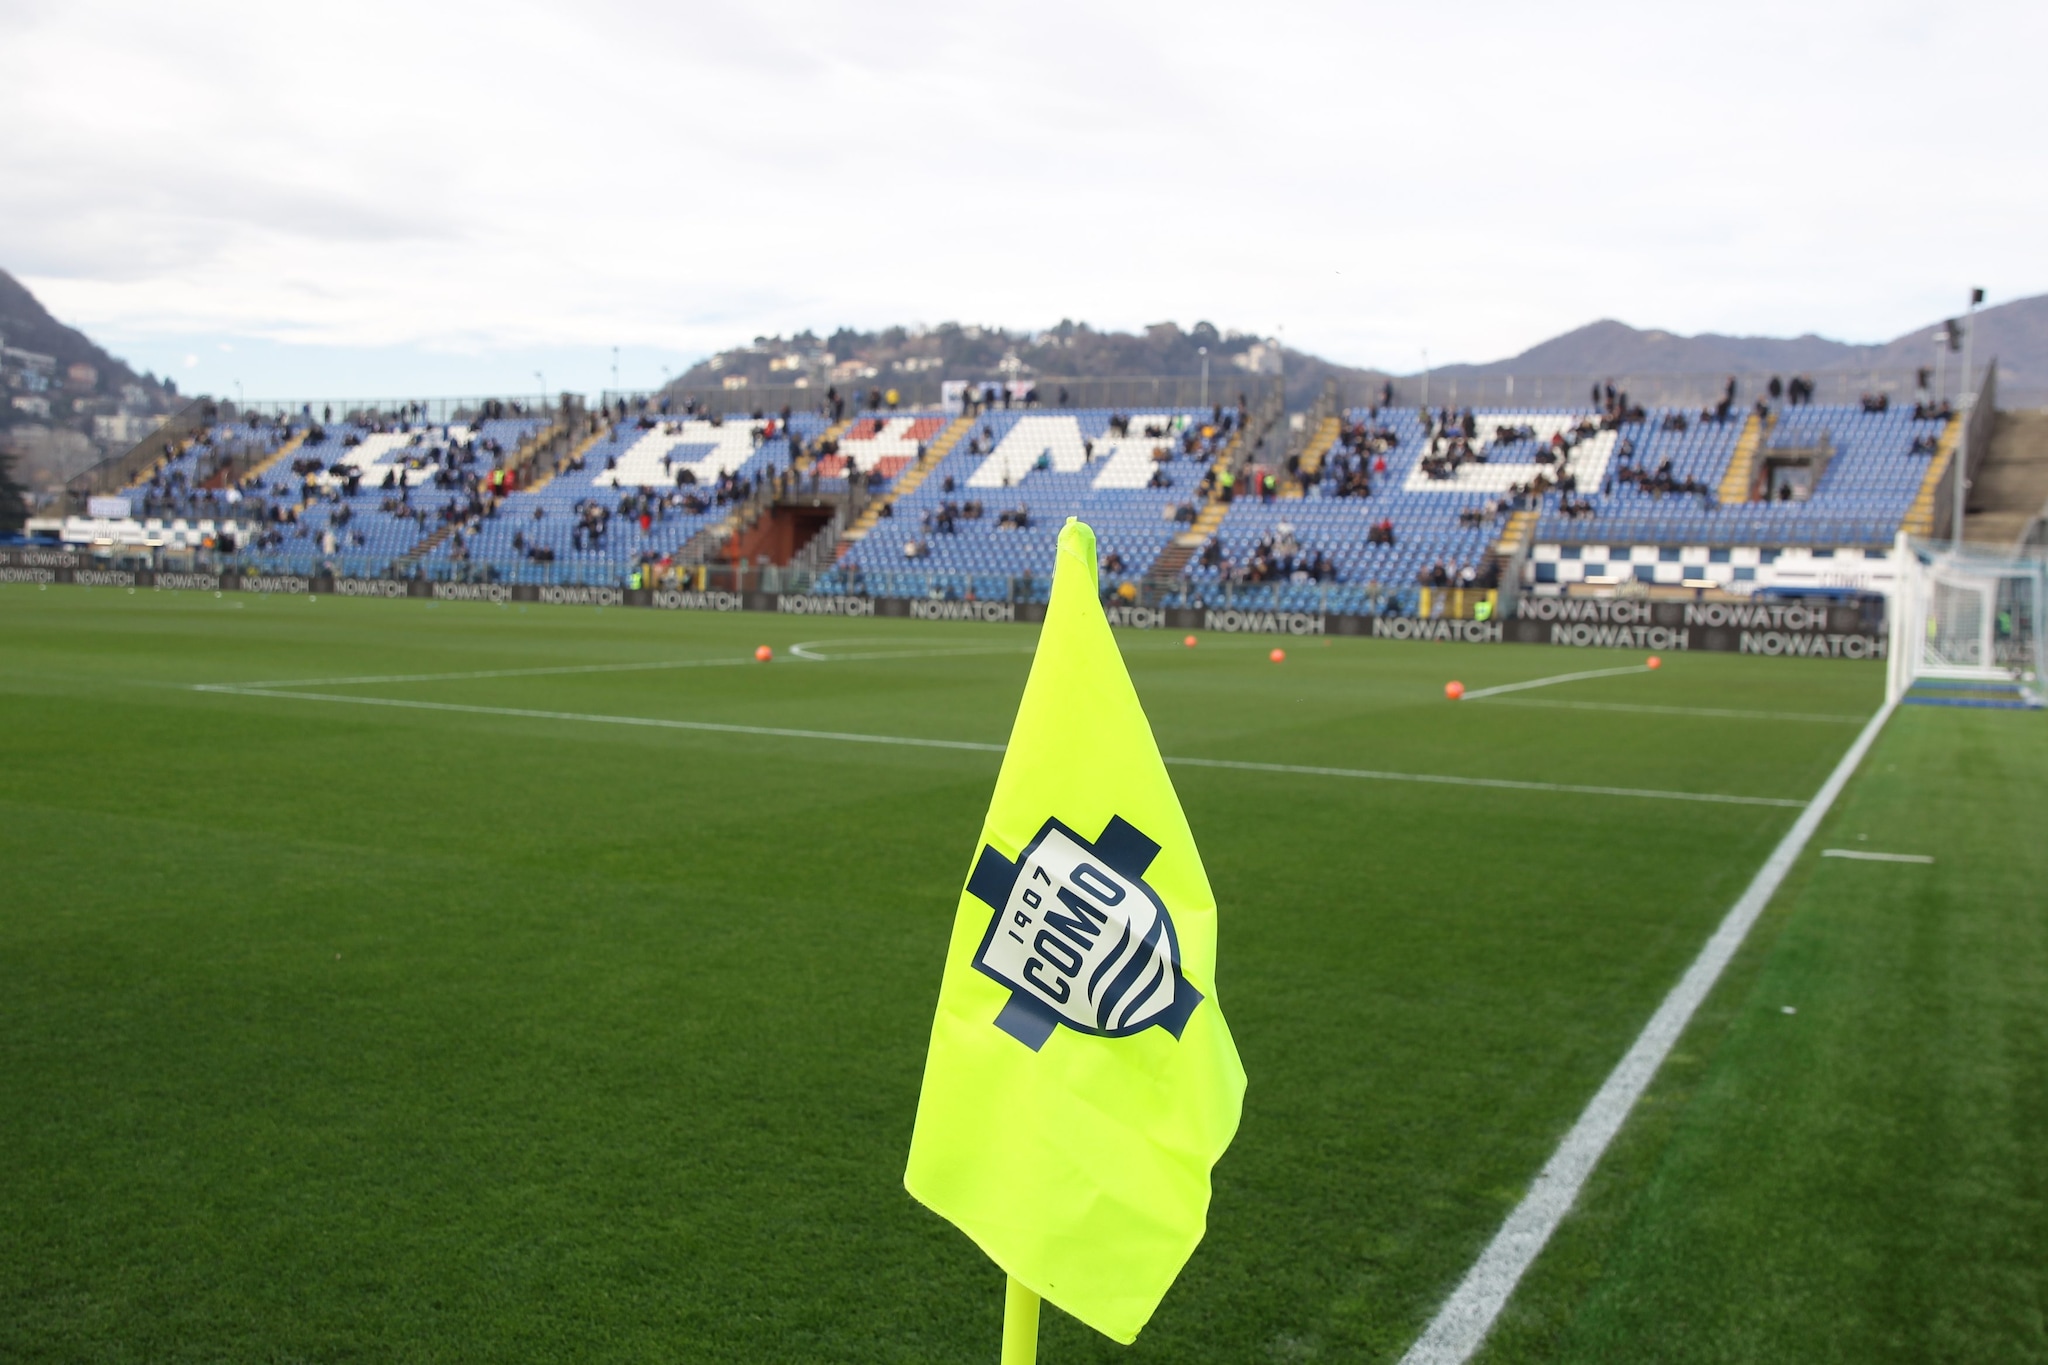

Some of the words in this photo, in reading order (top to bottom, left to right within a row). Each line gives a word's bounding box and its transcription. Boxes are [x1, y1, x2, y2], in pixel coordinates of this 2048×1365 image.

[24, 552, 80, 568] NOWATCH
[0, 567, 55, 583] NOWATCH
[75, 569, 135, 587] NOWATCH
[156, 572, 219, 590] NOWATCH
[242, 575, 309, 593] NOWATCH
[334, 578, 407, 598] NOWATCH
[433, 582, 512, 602] NOWATCH
[539, 586, 624, 607] NOWATCH
[652, 590, 743, 612] NOWATCH
[777, 595, 875, 616] NOWATCH
[910, 600, 1015, 622] NOWATCH
[1517, 597, 1652, 622] NOWATCH
[1106, 606, 1166, 628] ATCH
[1205, 610, 1325, 635] NOWATCH
[1686, 603, 1826, 629] NOWATCH
[1372, 616, 1503, 642] NOWATCH
[1551, 623, 1689, 649] NOWATCH
[1742, 632, 1886, 659] NOWATCH
[1009, 866, 1051, 944] 1907
[1023, 862, 1126, 1004] COMO
